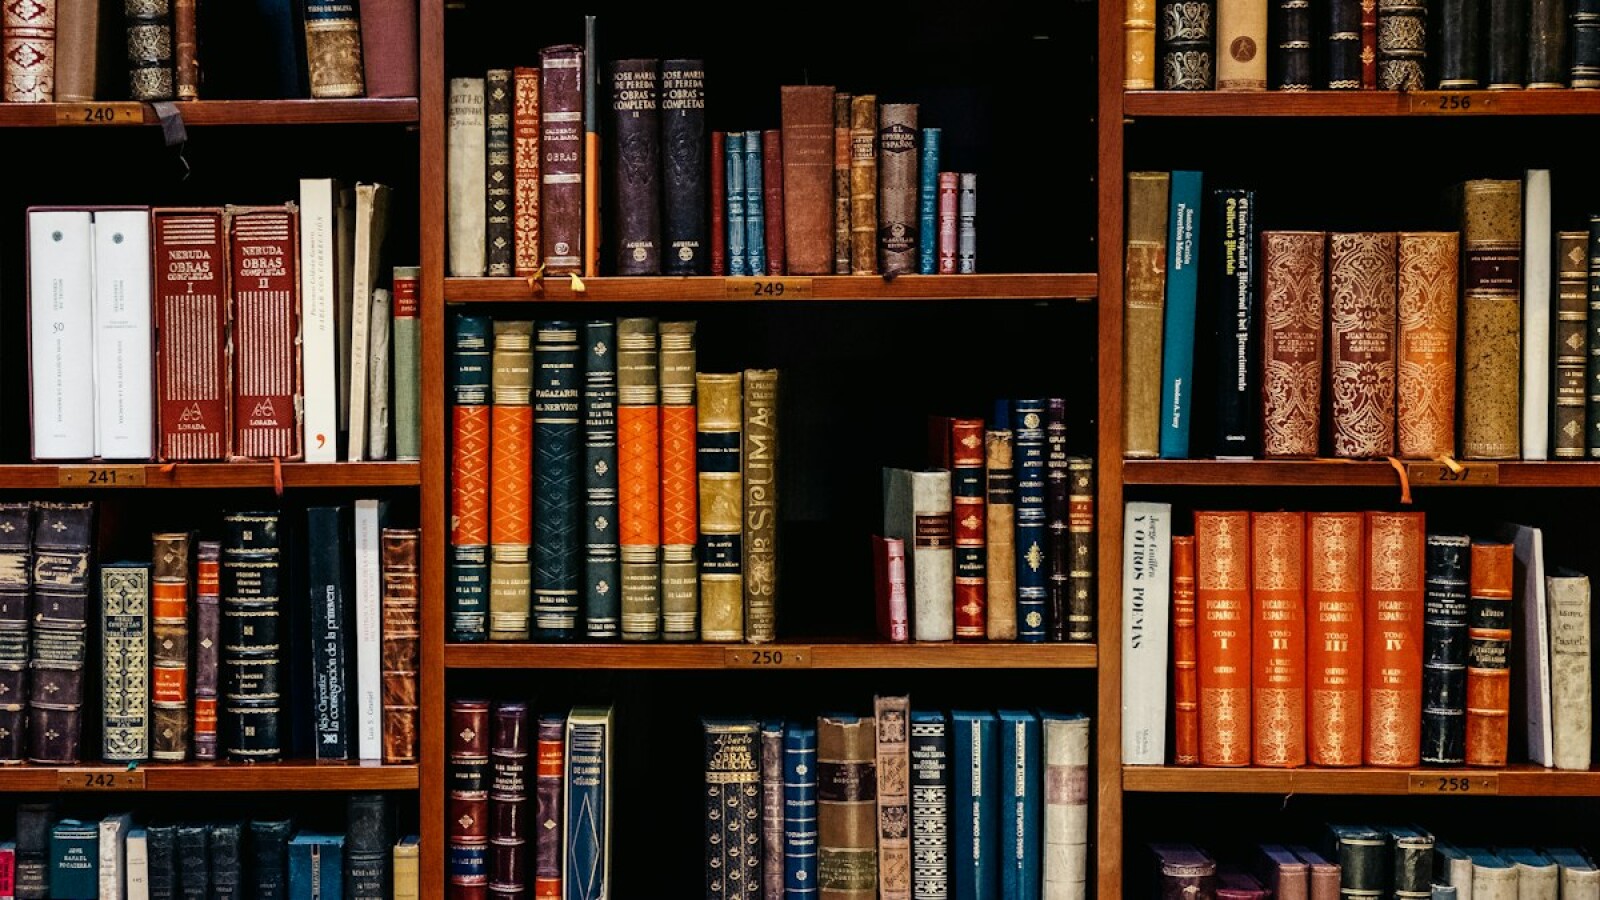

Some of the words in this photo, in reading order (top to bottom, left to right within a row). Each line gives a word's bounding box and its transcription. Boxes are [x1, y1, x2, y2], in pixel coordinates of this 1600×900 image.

[614, 72, 633, 81] JOSE
[662, 70, 682, 79] JOSE
[615, 81, 624, 89] DE
[626, 80, 654, 89] PEREDA
[663, 79, 673, 88] DE
[675, 79, 703, 88] PEREDA
[620, 90, 648, 100] OBRAS
[669, 89, 697, 99] OBRAS
[613, 100, 656, 110] COMPLETAS
[662, 99, 705, 109] COMPLETAS
[1439, 96, 1471, 109] 256
[84, 107, 115, 122] 240
[881, 140, 914, 149] ESPAÑOL
[546, 152, 578, 162] OBRAS
[1176, 203, 1186, 240] Proverbios
[1226, 198, 1236, 238] Edilberto
[1238, 209, 1248, 236] teatro
[168, 250, 211, 260] NERUDA
[242, 246, 284, 256] NERUDA
[1175, 240, 1184, 270] Morales
[1237, 237, 1248, 269] español
[169, 262, 210, 273] OBRAS
[242, 258, 282, 269] OBRAS
[167, 272, 214, 281] COMPLETAS
[240, 268, 286, 277] COMPLETAS
[187, 282, 194, 293] I
[753, 282, 785, 296] 249
[52, 322, 65, 334] 50
[1238, 318, 1248, 330] del
[1236, 332, 1248, 391] Renacimiento
[545, 403, 578, 412] NERVION
[249, 419, 278, 427] LOSADA
[88, 470, 117, 483] 241
[1134, 515, 1146, 523] Y
[1147, 515, 1159, 542] Jorge
[1133, 529, 1146, 580] OTROS
[324, 584, 339, 630] primavera
[1131, 587, 1145, 649] POEMAS
[324, 631, 337, 640] la
[1212, 630, 1236, 638] TOMO
[1324, 632, 1349, 640] TOMO
[1383, 631, 1407, 639] TOMO
[325, 642, 337, 657] de
[1221, 638, 1228, 650] I
[1273, 638, 1288, 650] II
[1325, 640, 1348, 652] III
[1385, 640, 1405, 651] IV
[751, 651, 783, 665] 250
[317, 673, 329, 713] Carpentier
[326, 658, 341, 720] consagración
[714, 734, 752, 745] Alberto
[713, 752, 752, 761] OBRAS
[709, 760, 757, 770] SELECTAS
[85, 774, 115, 787] 242
[1438, 778, 1470, 792] 258
